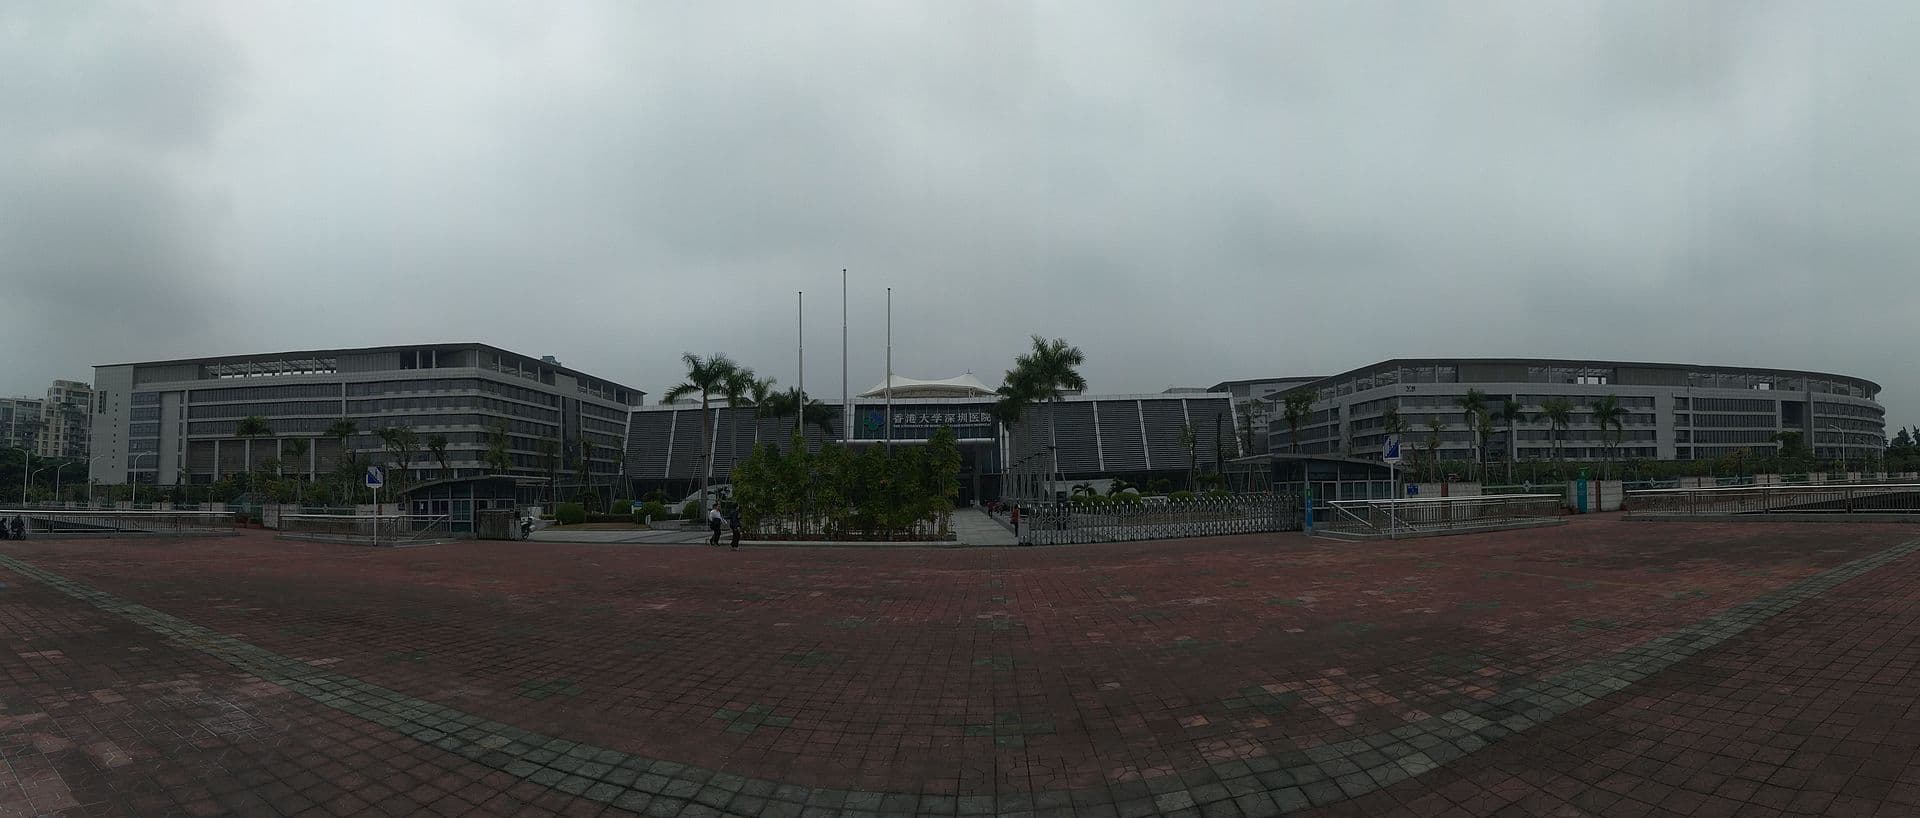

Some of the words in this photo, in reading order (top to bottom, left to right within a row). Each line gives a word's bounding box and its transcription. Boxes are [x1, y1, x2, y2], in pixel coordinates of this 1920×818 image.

[893, 412, 992, 423] 香港大学深圳医院
